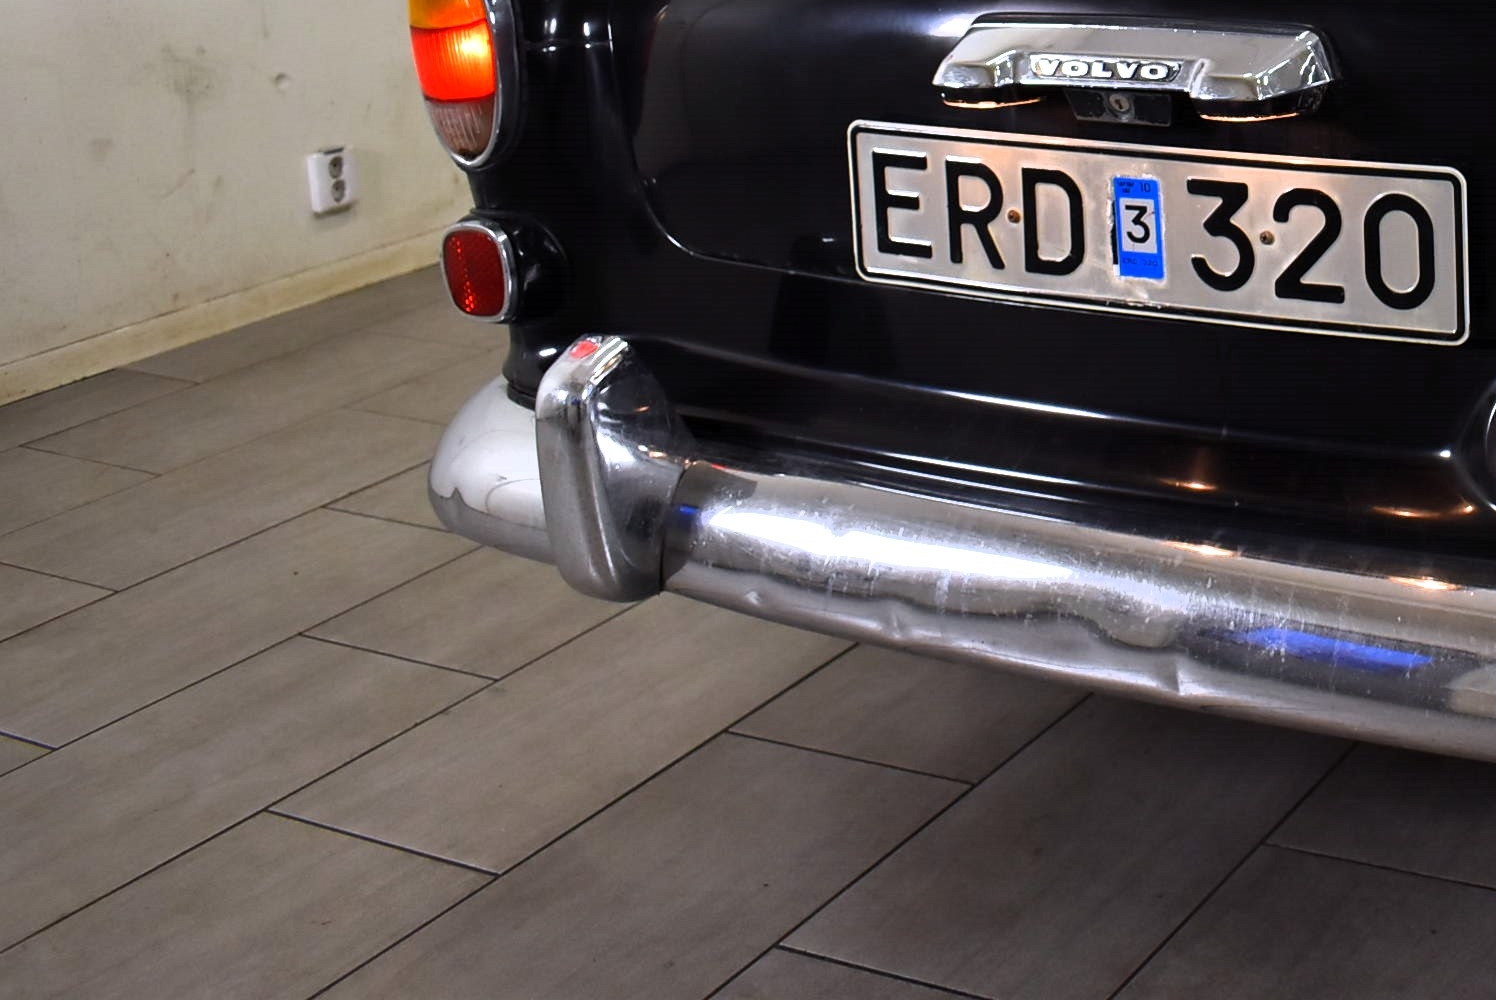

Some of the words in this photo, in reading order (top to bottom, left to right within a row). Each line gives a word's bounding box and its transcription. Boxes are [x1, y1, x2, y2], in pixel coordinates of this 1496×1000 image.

[1035, 58, 1169, 80] VOLVO
[872, 147, 1086, 276] ERD
[1187, 176, 1436, 310] 320
[1125, 205, 1151, 244] 3
